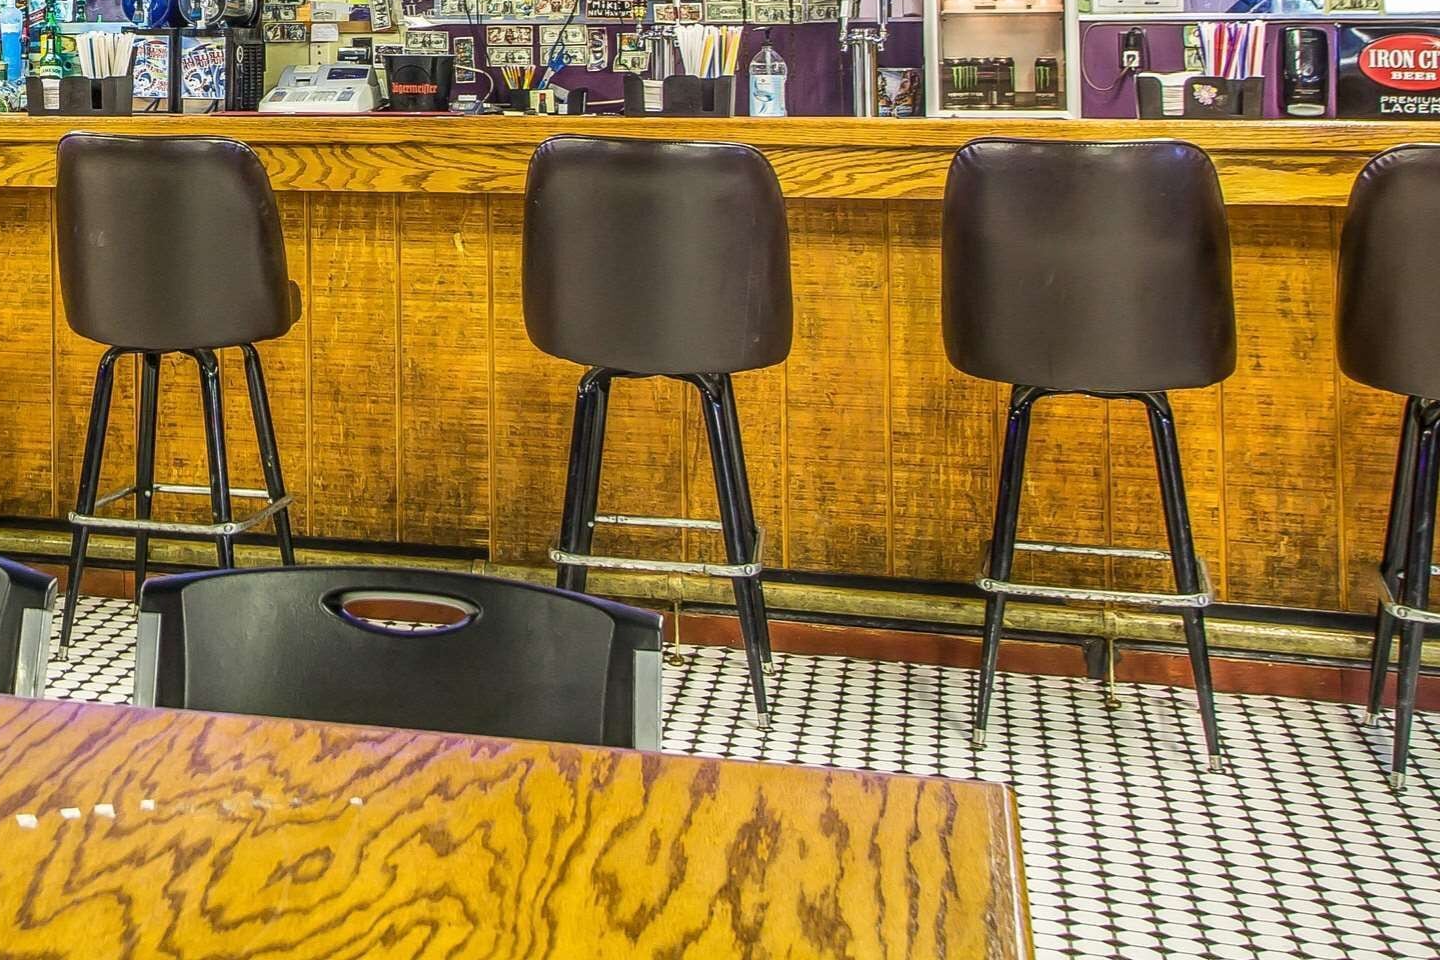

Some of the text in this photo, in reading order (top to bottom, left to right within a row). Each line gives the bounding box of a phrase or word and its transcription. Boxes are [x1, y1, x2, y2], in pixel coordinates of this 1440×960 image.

[1368, 49, 1415, 68] IRON
[1391, 71, 1437, 81] BEER
[1380, 96, 1440, 104] PREMIUM
[1380, 103, 1440, 114] LAGER
